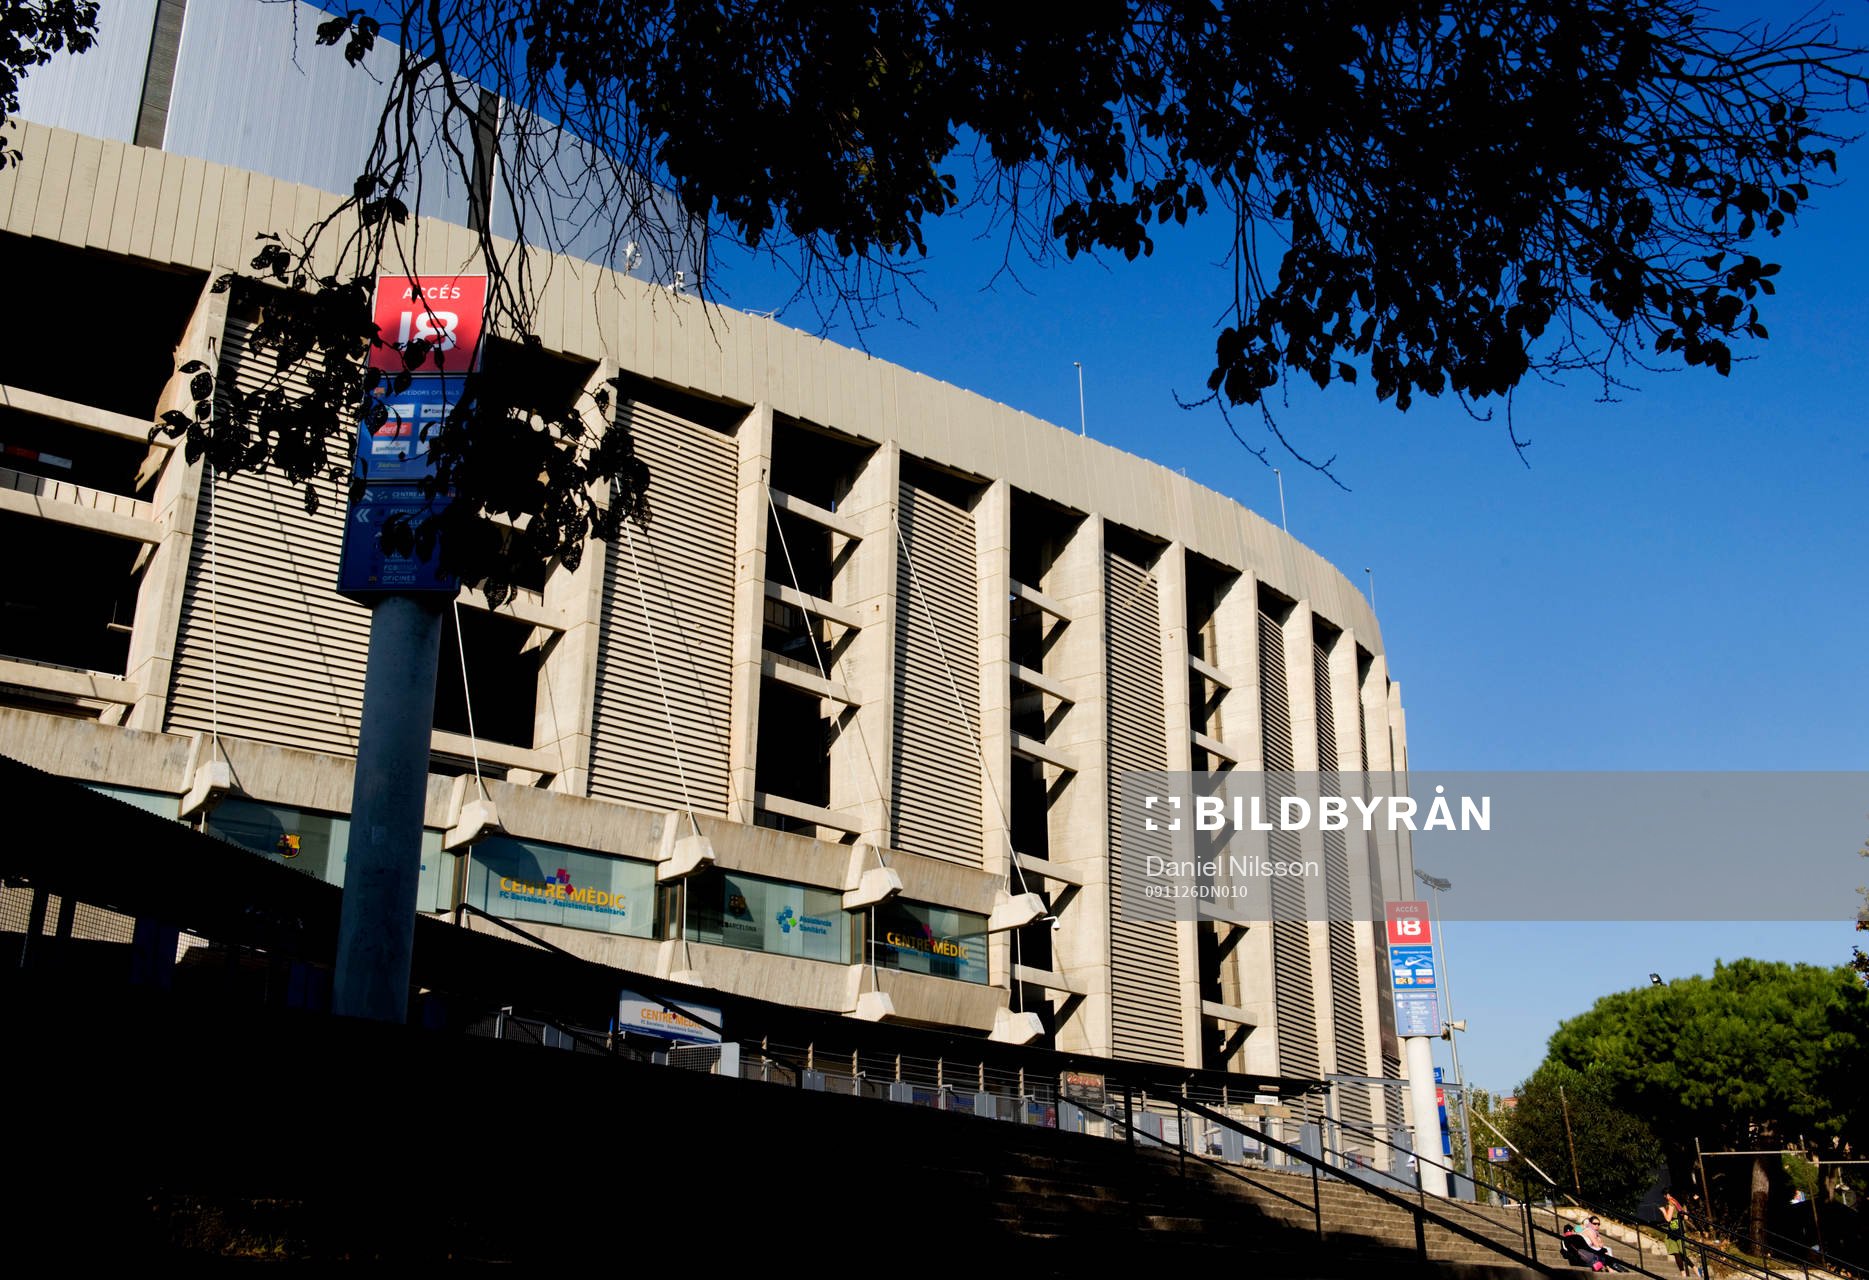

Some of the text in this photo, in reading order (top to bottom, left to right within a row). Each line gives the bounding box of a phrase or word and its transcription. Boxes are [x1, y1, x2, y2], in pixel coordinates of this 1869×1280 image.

[398, 311, 459, 352] 18
[499, 890, 509, 899] FC
[511, 892, 547, 905] Barcelona
[500, 877, 566, 900] CENTRE
[1397, 917, 1422, 936] 18
[887, 932, 931, 951] CENTRE
[641, 1008, 673, 1024] CENTRE
